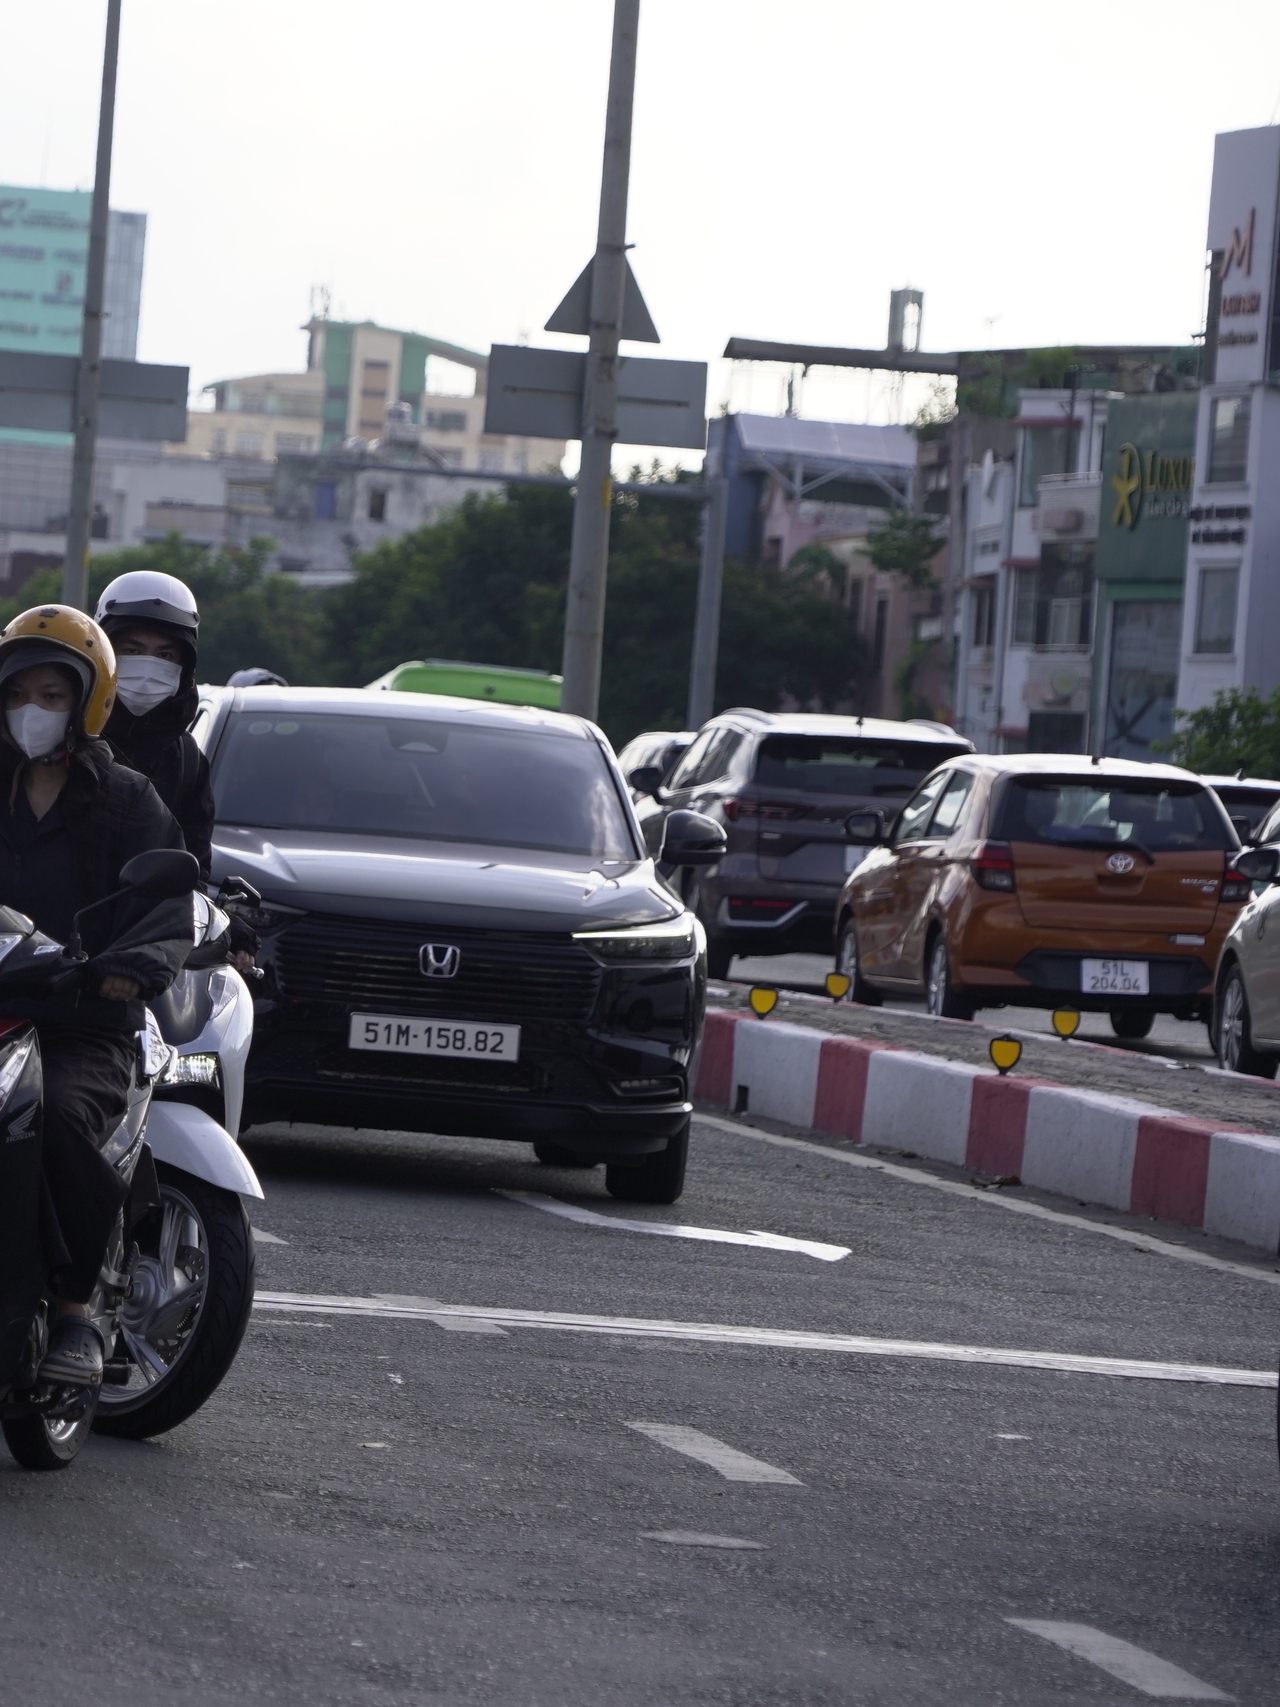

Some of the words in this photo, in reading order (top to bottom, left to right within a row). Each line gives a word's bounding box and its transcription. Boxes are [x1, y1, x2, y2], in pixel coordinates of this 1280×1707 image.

[1102, 961, 1130, 976] 51L
[1090, 975, 1141, 991] 204.04
[363, 1021, 505, 1054] 51M-158.82
[5, 1130, 36, 1144] HONDA
